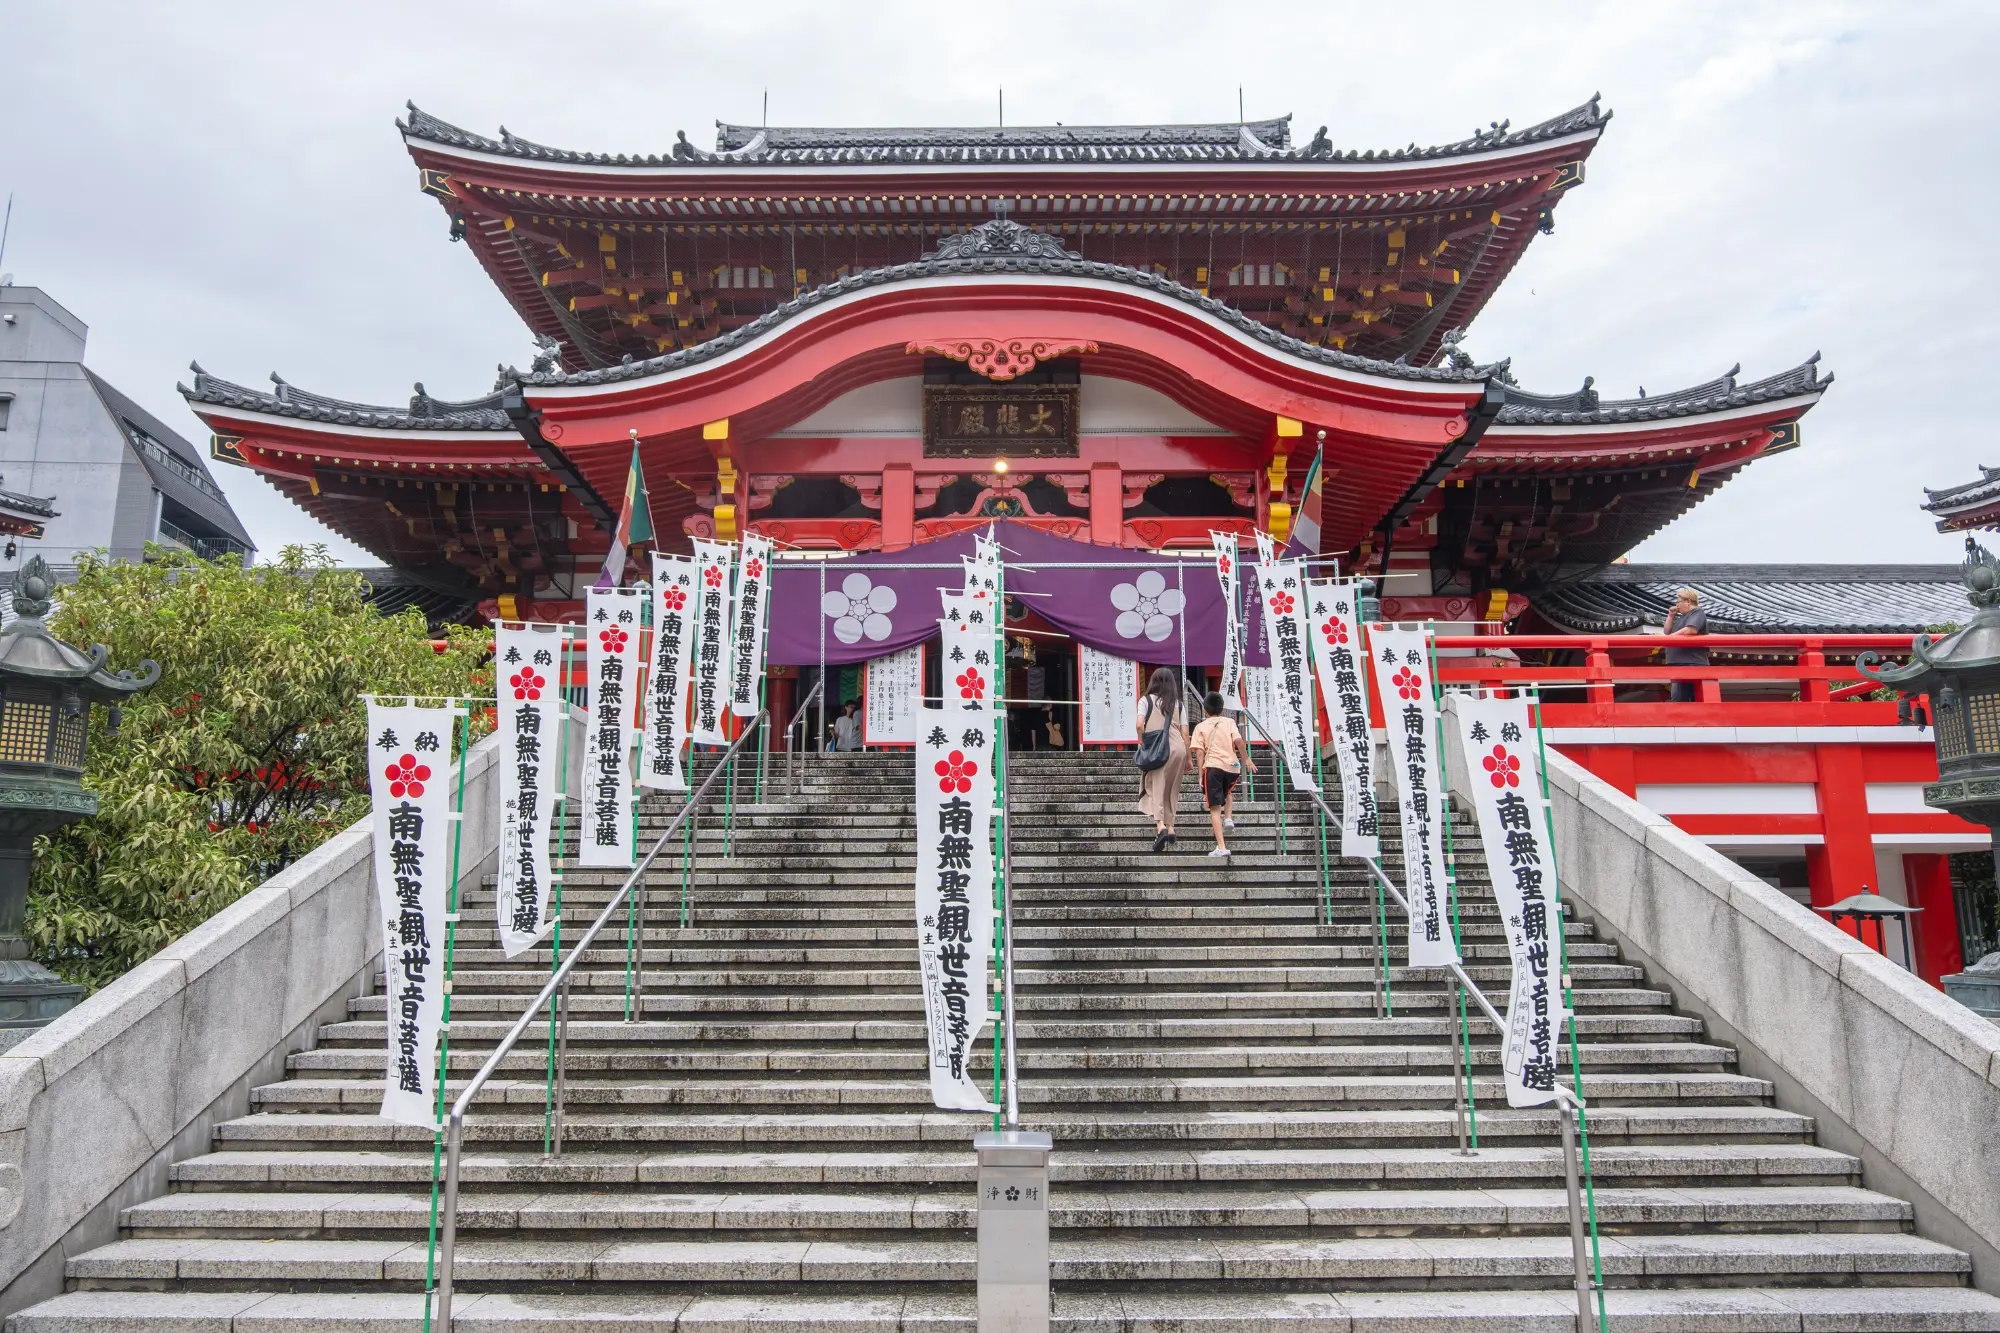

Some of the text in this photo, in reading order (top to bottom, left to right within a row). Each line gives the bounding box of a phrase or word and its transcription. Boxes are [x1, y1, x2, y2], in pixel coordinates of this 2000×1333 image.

[658, 571, 690, 586] 奉納
[969, 574, 994, 590] 奉納
[1264, 577, 1297, 591] 奉納
[593, 607, 634, 623] 奉納
[947, 607, 984, 624] 奉納
[1314, 601, 1349, 616] 奉納
[503, 646, 553, 667] 奉納
[949, 645, 990, 666] 奉納
[1381, 647, 1422, 666] 奉納
[653, 612, 682, 776] 南無聖観世音菩薩
[375, 728, 440, 752] 奉納
[589, 734, 598, 754] 施主
[926, 726, 985, 749] 奉納
[1329, 646, 1378, 836] 南無聖観世音菩薩
[1470, 720, 1522, 744] 奉納
[595, 655, 623, 847] 南無聖観世音菩薩
[506, 799, 517, 824] 施主
[512, 703, 542, 935] 南無聖観世音菩薩
[1405, 799, 1415, 825] 施主
[387, 919, 398, 949] 施主
[923, 915, 935, 945] 施主
[1496, 791, 1556, 1091] 南無聖観世音菩薩
[1509, 915, 1524, 947] 施主
[388, 801, 431, 1095] 南無聖観世音菩薩
[987, 1186, 1039, 1201] 浄財
